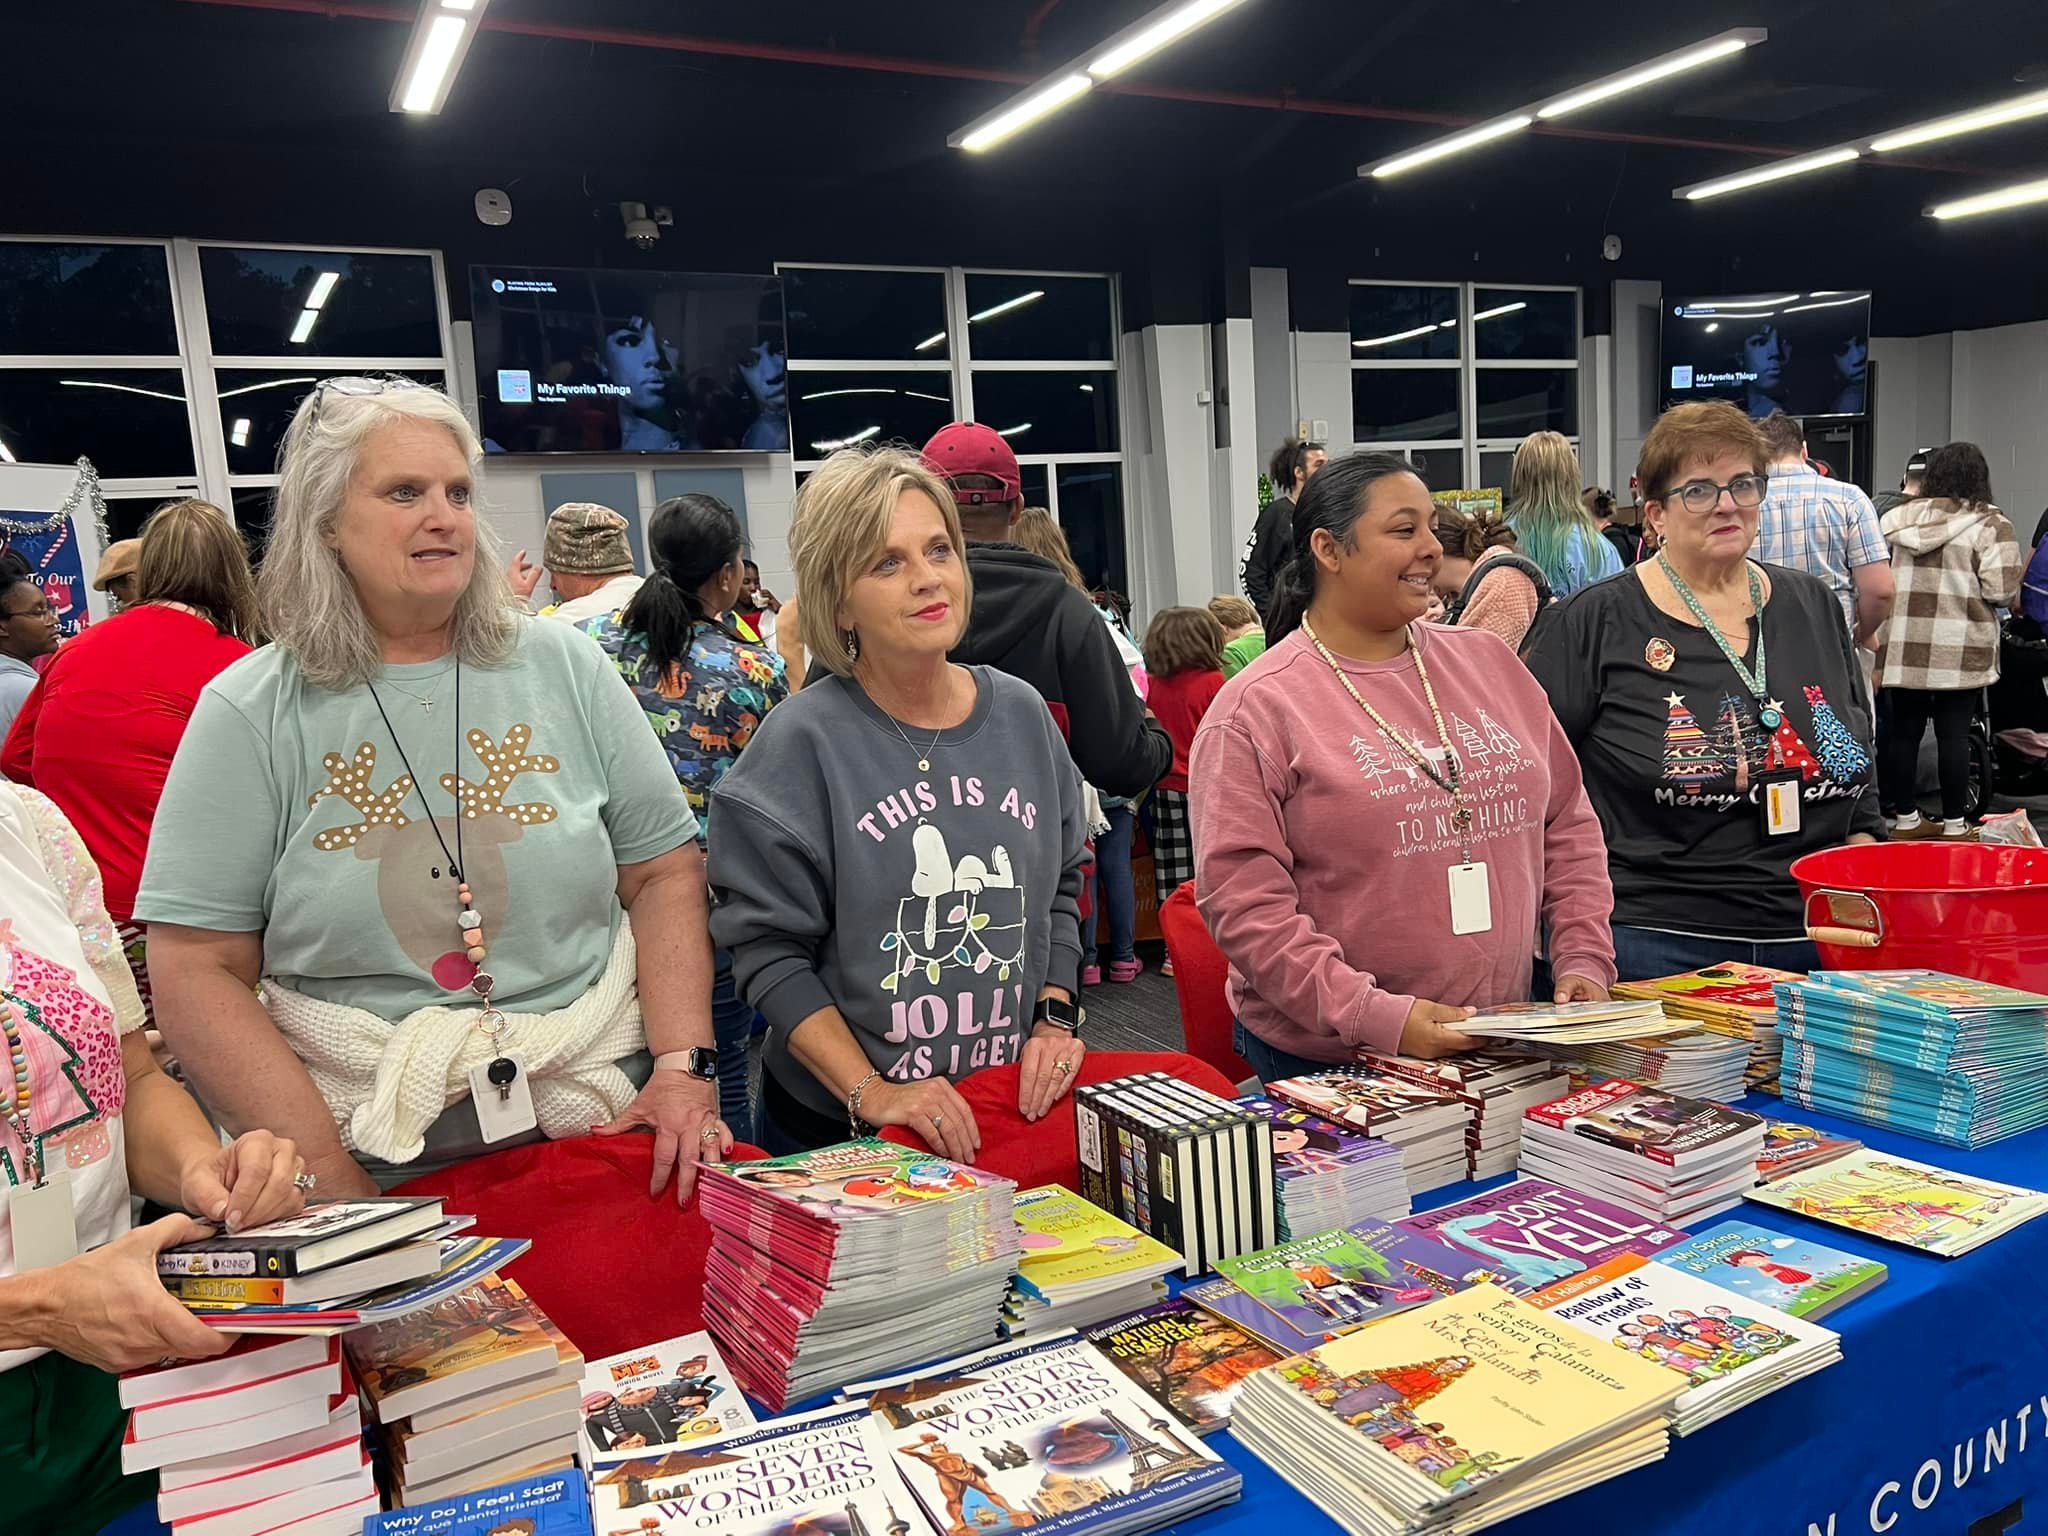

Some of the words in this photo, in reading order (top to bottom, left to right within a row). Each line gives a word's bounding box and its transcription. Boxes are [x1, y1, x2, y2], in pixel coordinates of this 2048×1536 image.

[537, 383, 555, 395] My
[556, 383, 597, 394] Favorite
[597, 383, 631, 396] Things
[1696, 374, 1707, 382] My
[1708, 373, 1734, 381] Favorite
[1735, 372, 1757, 381] Things
[26, 572, 43, 586] To
[48, 572, 76, 586] Our
[1370, 779, 1407, 800] where
[1409, 778, 1431, 793] the
[1459, 763, 1490, 784] tops
[1495, 757, 1536, 780] glisten
[856, 780, 937, 842] THIS
[950, 775, 985, 807] IS
[1000, 787, 1037, 831] AS
[1406, 795, 1428, 814] and
[1479, 782, 1518, 800] listen
[1654, 787, 1741, 812] Merry
[1396, 819, 1425, 844] TO
[887, 1046, 933, 1080] AS
[948, 1045, 960, 1074] I
[798, 1147, 899, 1168] DINOSAUR
[1410, 1206, 1477, 1231] Little
[1479, 1183, 1544, 1210] Dinos
[1486, 1189, 1585, 1228] DON'T
[1306, 1230, 1344, 1247] Wear
[1492, 1208, 1655, 1262] YELL
[1672, 1246, 1698, 1265] My
[1693, 1232, 1741, 1252] Spring
[221, 1260, 250, 1269] KINNEY
[1245, 1258, 1285, 1274] Leg
[1287, 1239, 1346, 1262] Braces
[1685, 1258, 1708, 1273] Mi
[1708, 1235, 1769, 1267] primavera
[1535, 1291, 1559, 1308] P.K.
[1557, 1273, 1605, 1302] Hallinan
[1553, 1286, 1627, 1320] Rainbow
[1626, 1276, 1651, 1293] of
[1473, 1311, 1531, 1344] señora
[1586, 1295, 1654, 1327] Friends
[1109, 1318, 1187, 1346] NATURAL
[1111, 1323, 1204, 1358] DISASTERS
[1442, 1312, 1466, 1331] The
[1466, 1327, 1501, 1351] Cats
[1499, 1347, 1519, 1356] of
[1514, 1317, 1564, 1344] gatos
[1561, 1340, 1578, 1351] de
[1577, 1346, 1593, 1358] la
[959, 1352, 1009, 1374] Wonders
[1011, 1348, 1025, 1359] of
[1025, 1338, 1076, 1356] Learning
[992, 1347, 1081, 1379] DISCOVER
[1424, 1319, 1457, 1344] Mrs.
[1464, 1342, 1542, 1386] Calamari
[617, 1376, 641, 1387] JUNIOR
[643, 1370, 664, 1379] NOVEL
[944, 1390, 982, 1407] THE
[982, 1356, 1095, 1402] SEVEN
[724, 1408, 741, 1420] 8
[926, 1372, 1111, 1434] WONDERS
[969, 1423, 996, 1438] OF
[998, 1410, 1045, 1430] THE
[1048, 1386, 1119, 1416] WORLD
[723, 1426, 783, 1449] Wonders
[787, 1422, 803, 1434] of
[805, 1413, 861, 1431] Learning
[755, 1423, 862, 1458] DISCOVER
[690, 1468, 734, 1487] THE
[735, 1436, 866, 1484] SEVEN
[383, 1511, 423, 1530] Why
[431, 1506, 457, 1519] Do
[464, 1503, 470, 1513] I
[477, 1492, 515, 1509] Feel
[521, 1480, 565, 1499] Sad?
[656, 1455, 873, 1520] WONDERS
[695, 1512, 729, 1529] OF
[731, 1498, 784, 1520] THE
[788, 1476, 876, 1506] WORLD
[1058, 1509, 1102, 1528] Medieval,
[1100, 1497, 1139, 1514] Modern,
[1139, 1489, 1156, 1501] and
[1155, 1478, 1187, 1495] Natural
[1186, 1466, 1226, 1484] Wonders
[457, 1508, 500, 1523] siento
[505, 1493, 562, 1513] tristeza?
